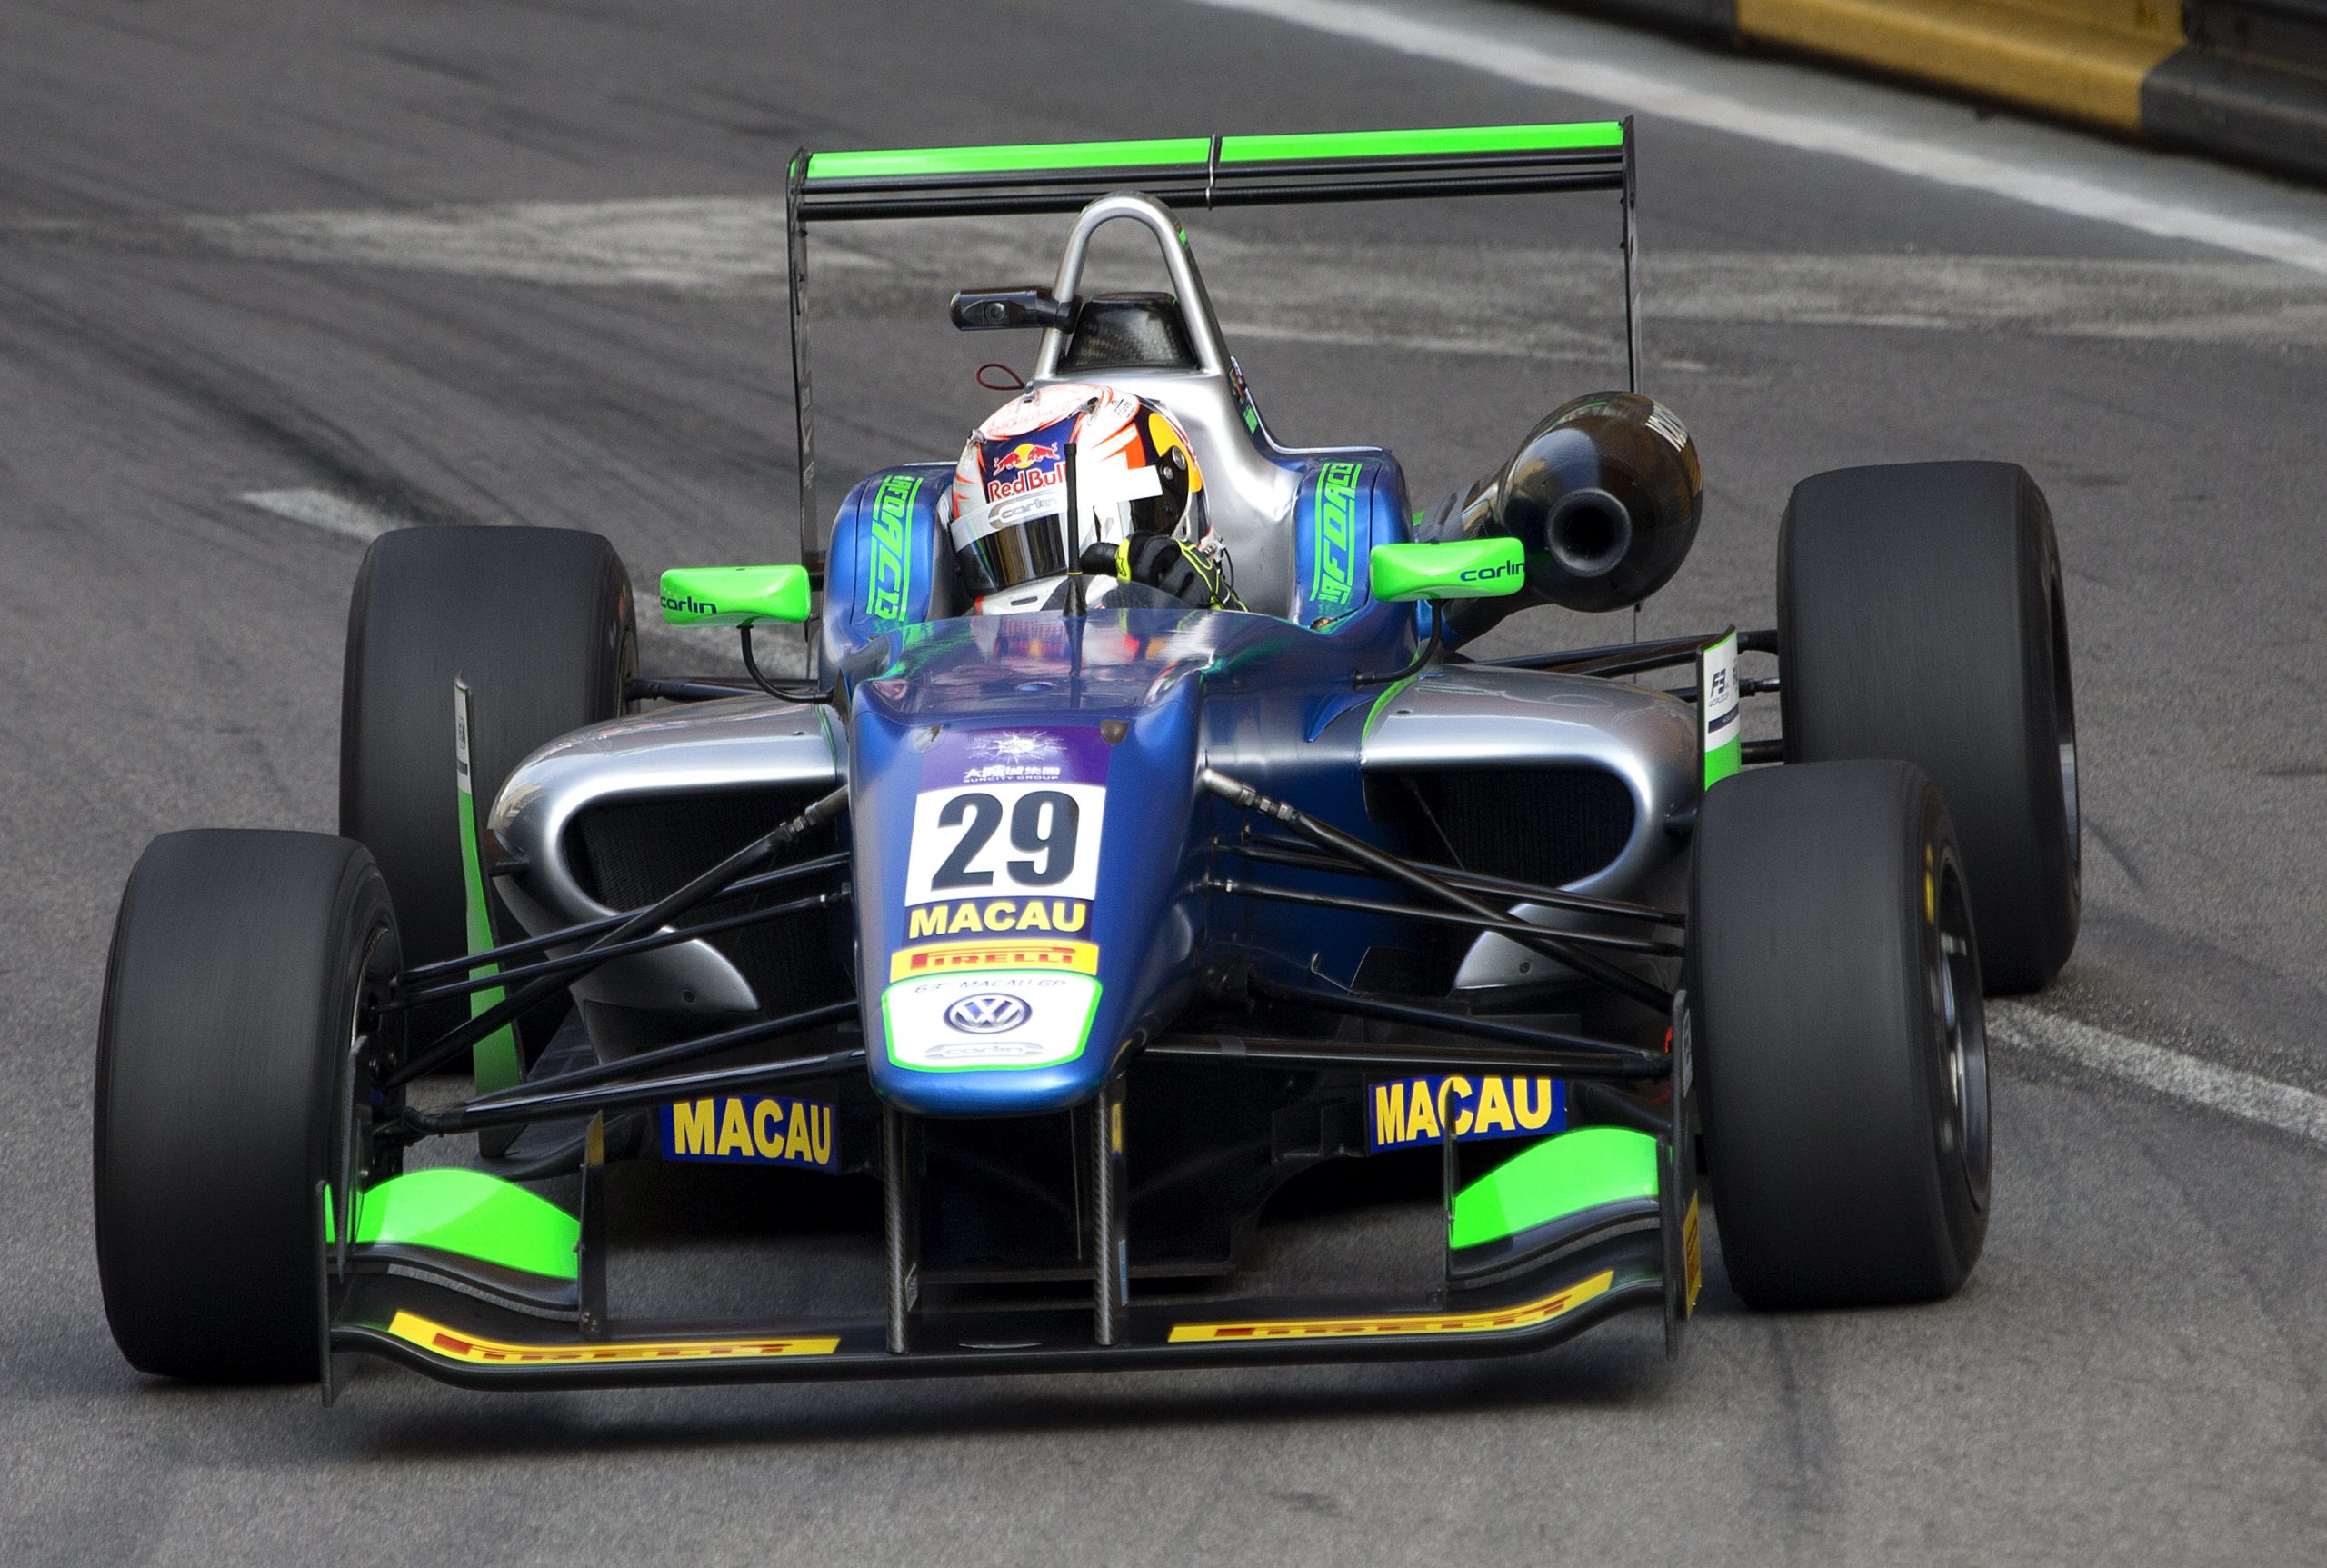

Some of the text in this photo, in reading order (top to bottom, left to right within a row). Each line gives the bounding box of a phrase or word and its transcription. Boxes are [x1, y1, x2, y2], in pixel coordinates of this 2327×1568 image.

[988, 461, 1066, 501] Red Bull
[1460, 560, 1525, 582] carlin
[660, 596, 716, 614] carlin
[930, 790, 1080, 892] 29
[908, 901, 1086, 939] MACAU
[910, 946, 1076, 970] PIRELLI
[959, 979, 1032, 988] MACAU
[1375, 1076, 1552, 1145] MACAU
[673, 1098, 831, 1164] MACAU
